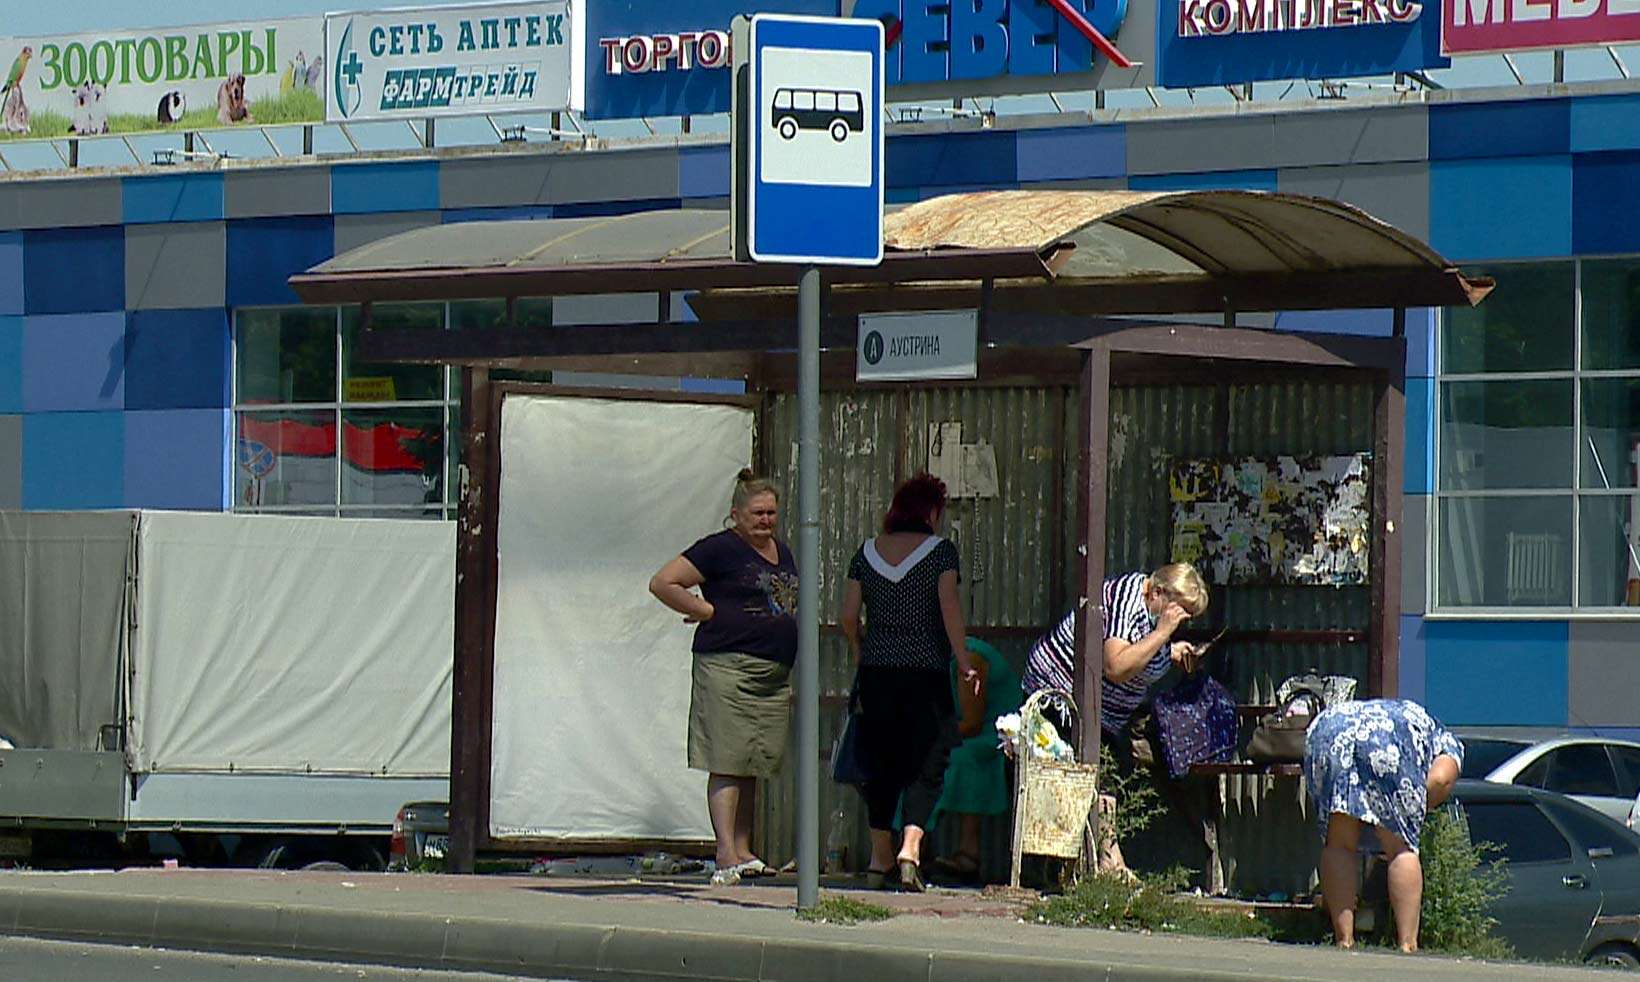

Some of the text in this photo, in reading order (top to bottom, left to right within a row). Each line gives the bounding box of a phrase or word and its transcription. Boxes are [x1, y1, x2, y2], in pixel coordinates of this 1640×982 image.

[369, 14, 564, 57] СЕТЬ АПТЕК
[1178, 0, 1423, 37] КОМПЛЕКС
[39, 28, 277, 90] ЗООТОВАРЫ
[599, 30, 733, 75] ТОРГО
[884, 0, 1129, 86] ЕВЕР
[382, 64, 537, 102] ФАРМТРЕЙД
[889, 335, 941, 357] АУСТРИНА
